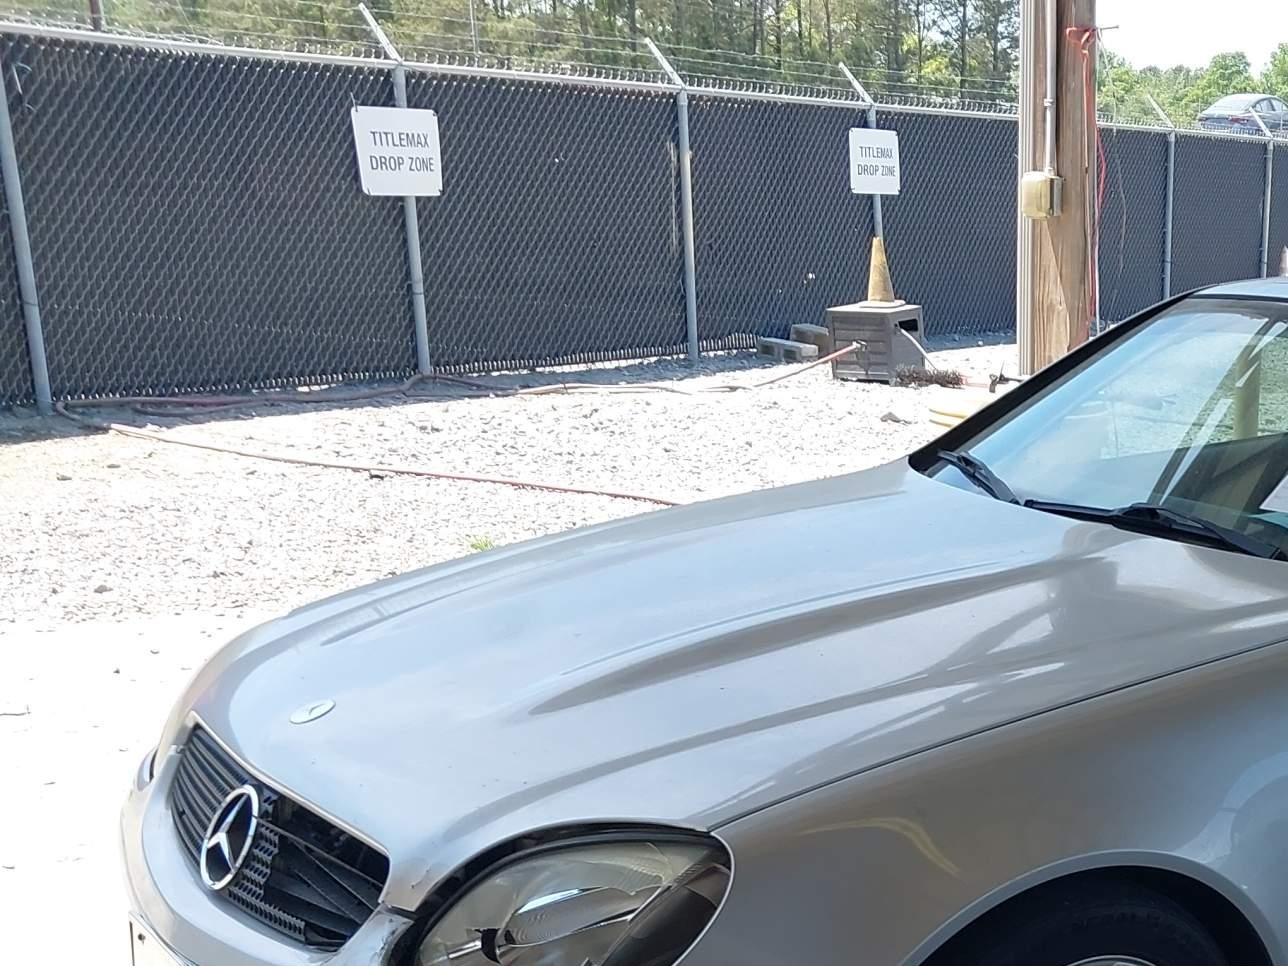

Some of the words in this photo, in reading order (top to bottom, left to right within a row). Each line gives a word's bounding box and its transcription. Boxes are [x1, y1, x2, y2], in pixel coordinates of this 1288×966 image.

[369, 130, 429, 148] TITLEMAX
[859, 145, 893, 159] TITLEMAX
[369, 155, 404, 171] DROP
[408, 156, 434, 172] ZONE
[857, 164, 879, 176] DROP
[881, 165, 896, 177] ZONE
